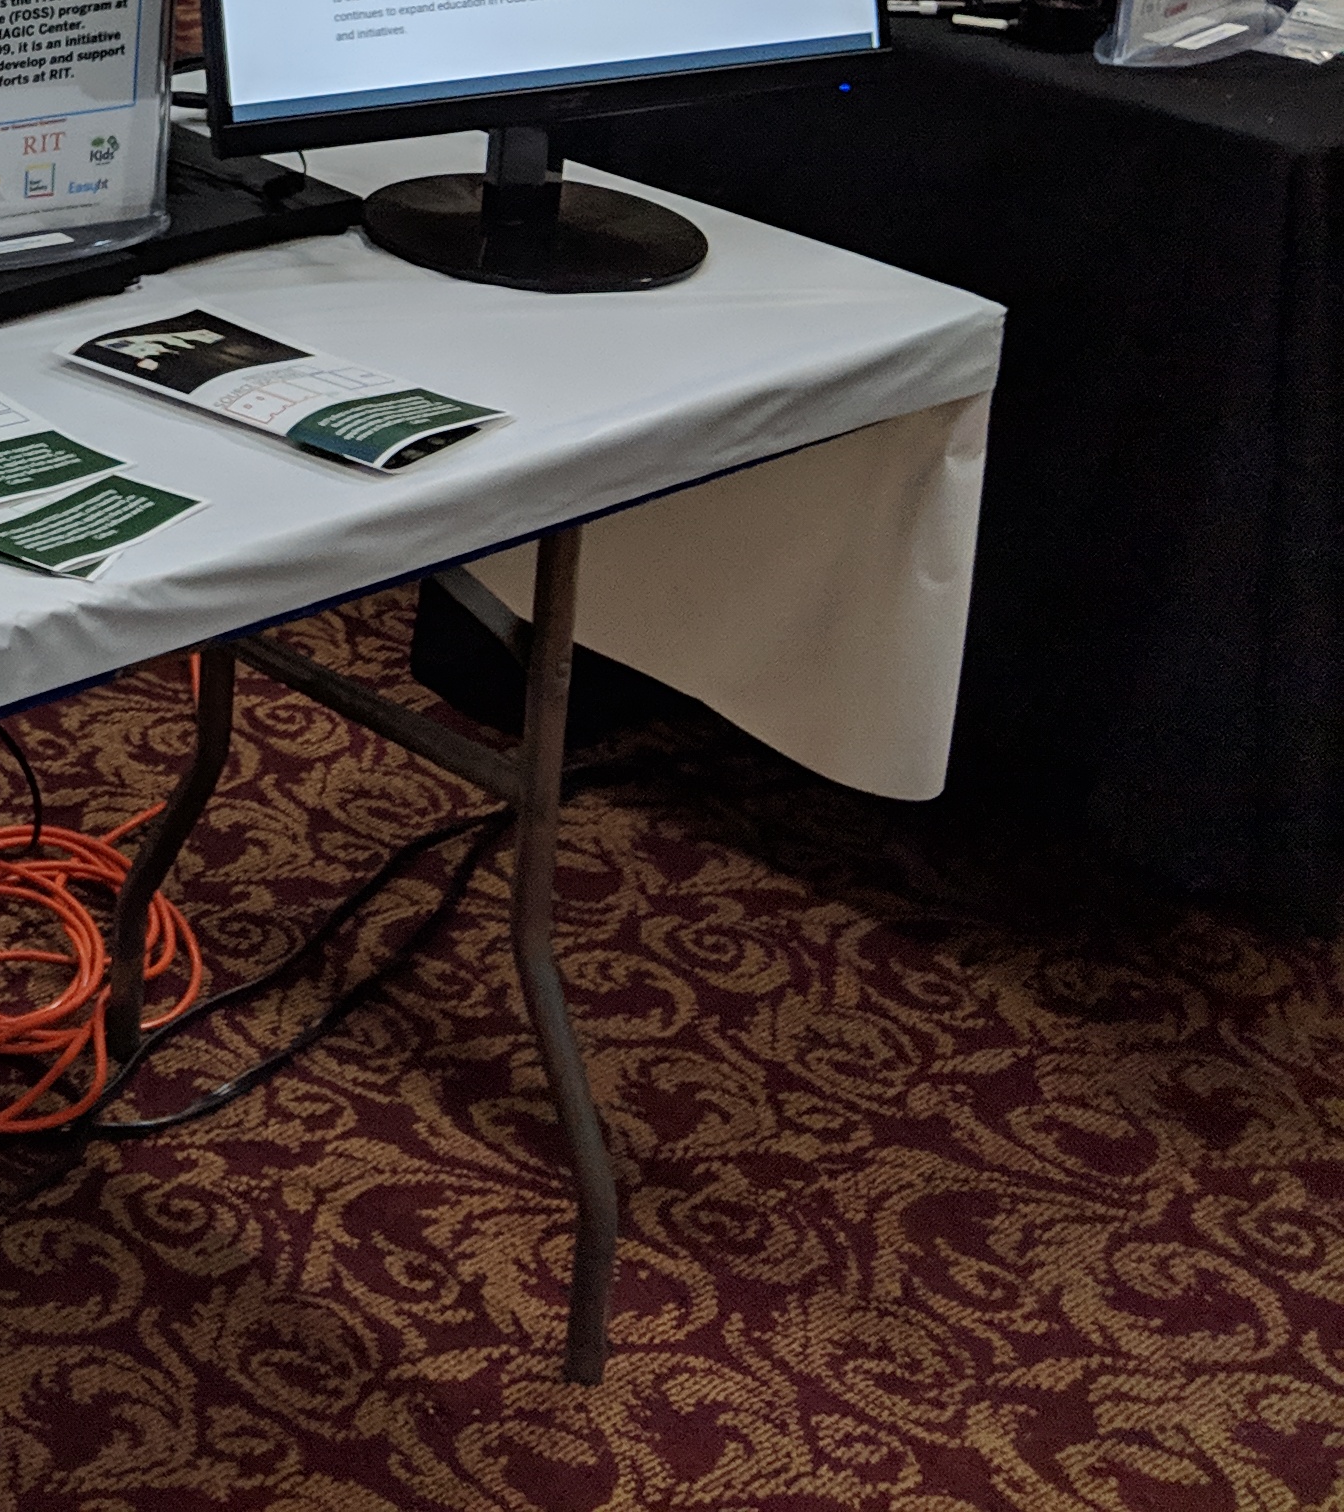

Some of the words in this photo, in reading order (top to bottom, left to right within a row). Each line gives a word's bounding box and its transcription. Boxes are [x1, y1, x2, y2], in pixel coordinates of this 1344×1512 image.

[9, 5, 56, 26] (FOSS)
[58, 0, 112, 20] program
[38, 19, 86, 36] Center.
[18, 42, 29, 54] it
[31, 39, 43, 52] is
[46, 38, 62, 50] an
[65, 30, 122, 47] initiative
[49, 51, 73, 65] and
[76, 44, 127, 64] support
[32, 71, 46, 84] at
[49, 67, 76, 82] RIT.
[22, 132, 67, 156] RIT
